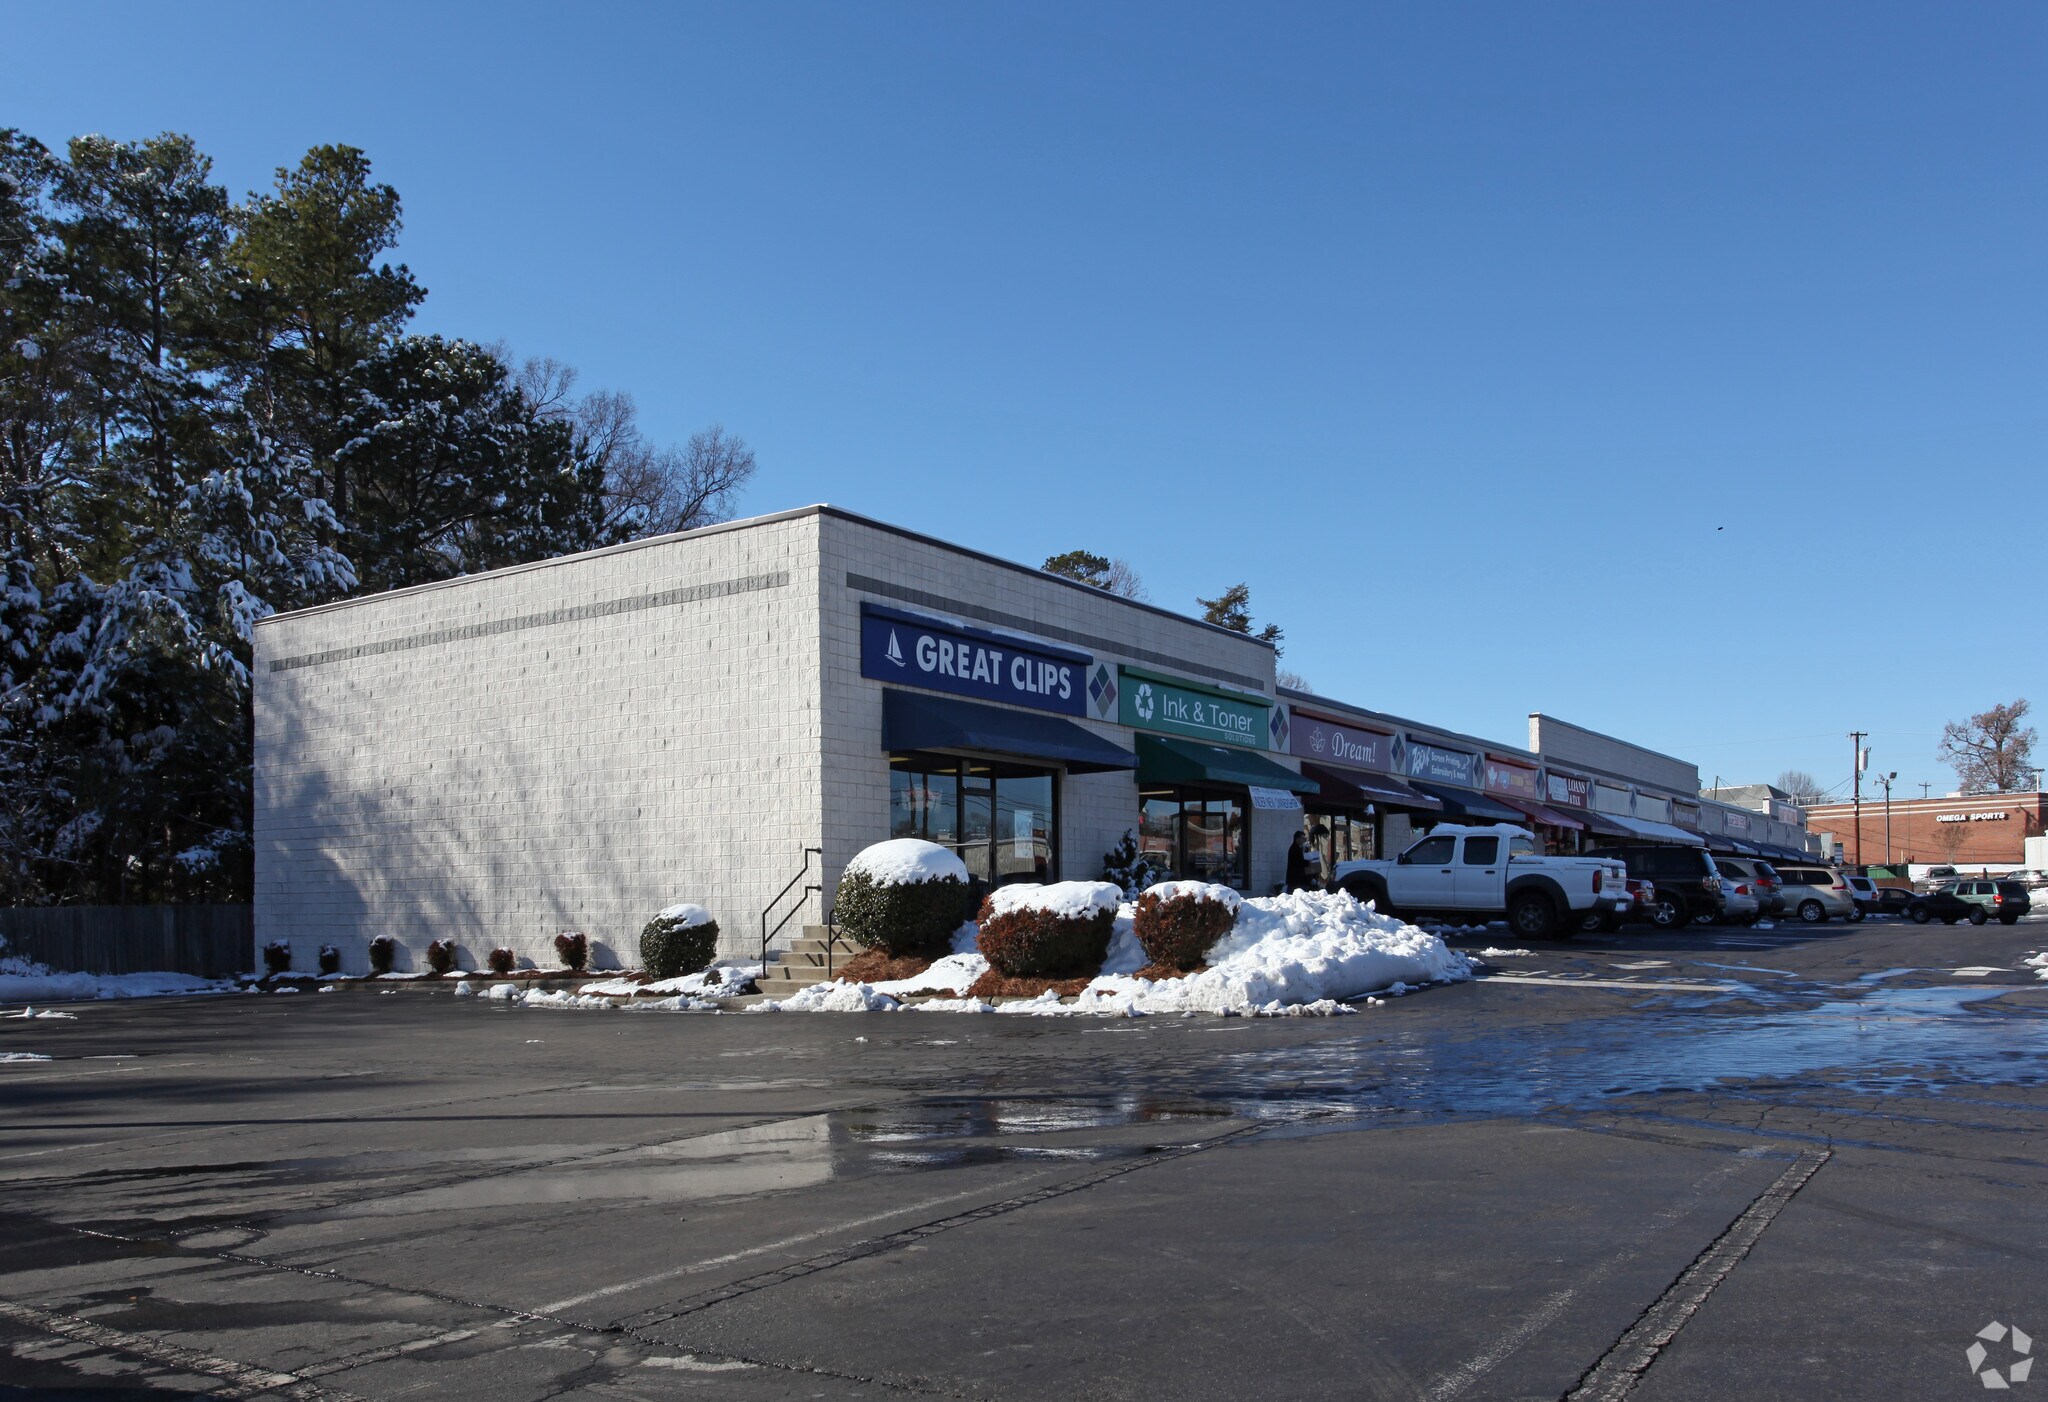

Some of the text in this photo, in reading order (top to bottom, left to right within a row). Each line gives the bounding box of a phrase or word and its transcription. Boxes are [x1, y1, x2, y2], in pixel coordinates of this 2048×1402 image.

[916, 635, 1072, 699] GREAT CLIPS
[1163, 694, 1253, 731] Ink & Toner
[1224, 732, 1256, 745] SOLUTIONS
[1331, 732, 1376, 763] Dream!
[1431, 751, 1445, 763] Screen
[1568, 777, 1586, 794] LOANS
[1936, 811, 2005, 822] OMEGA SPORTS
